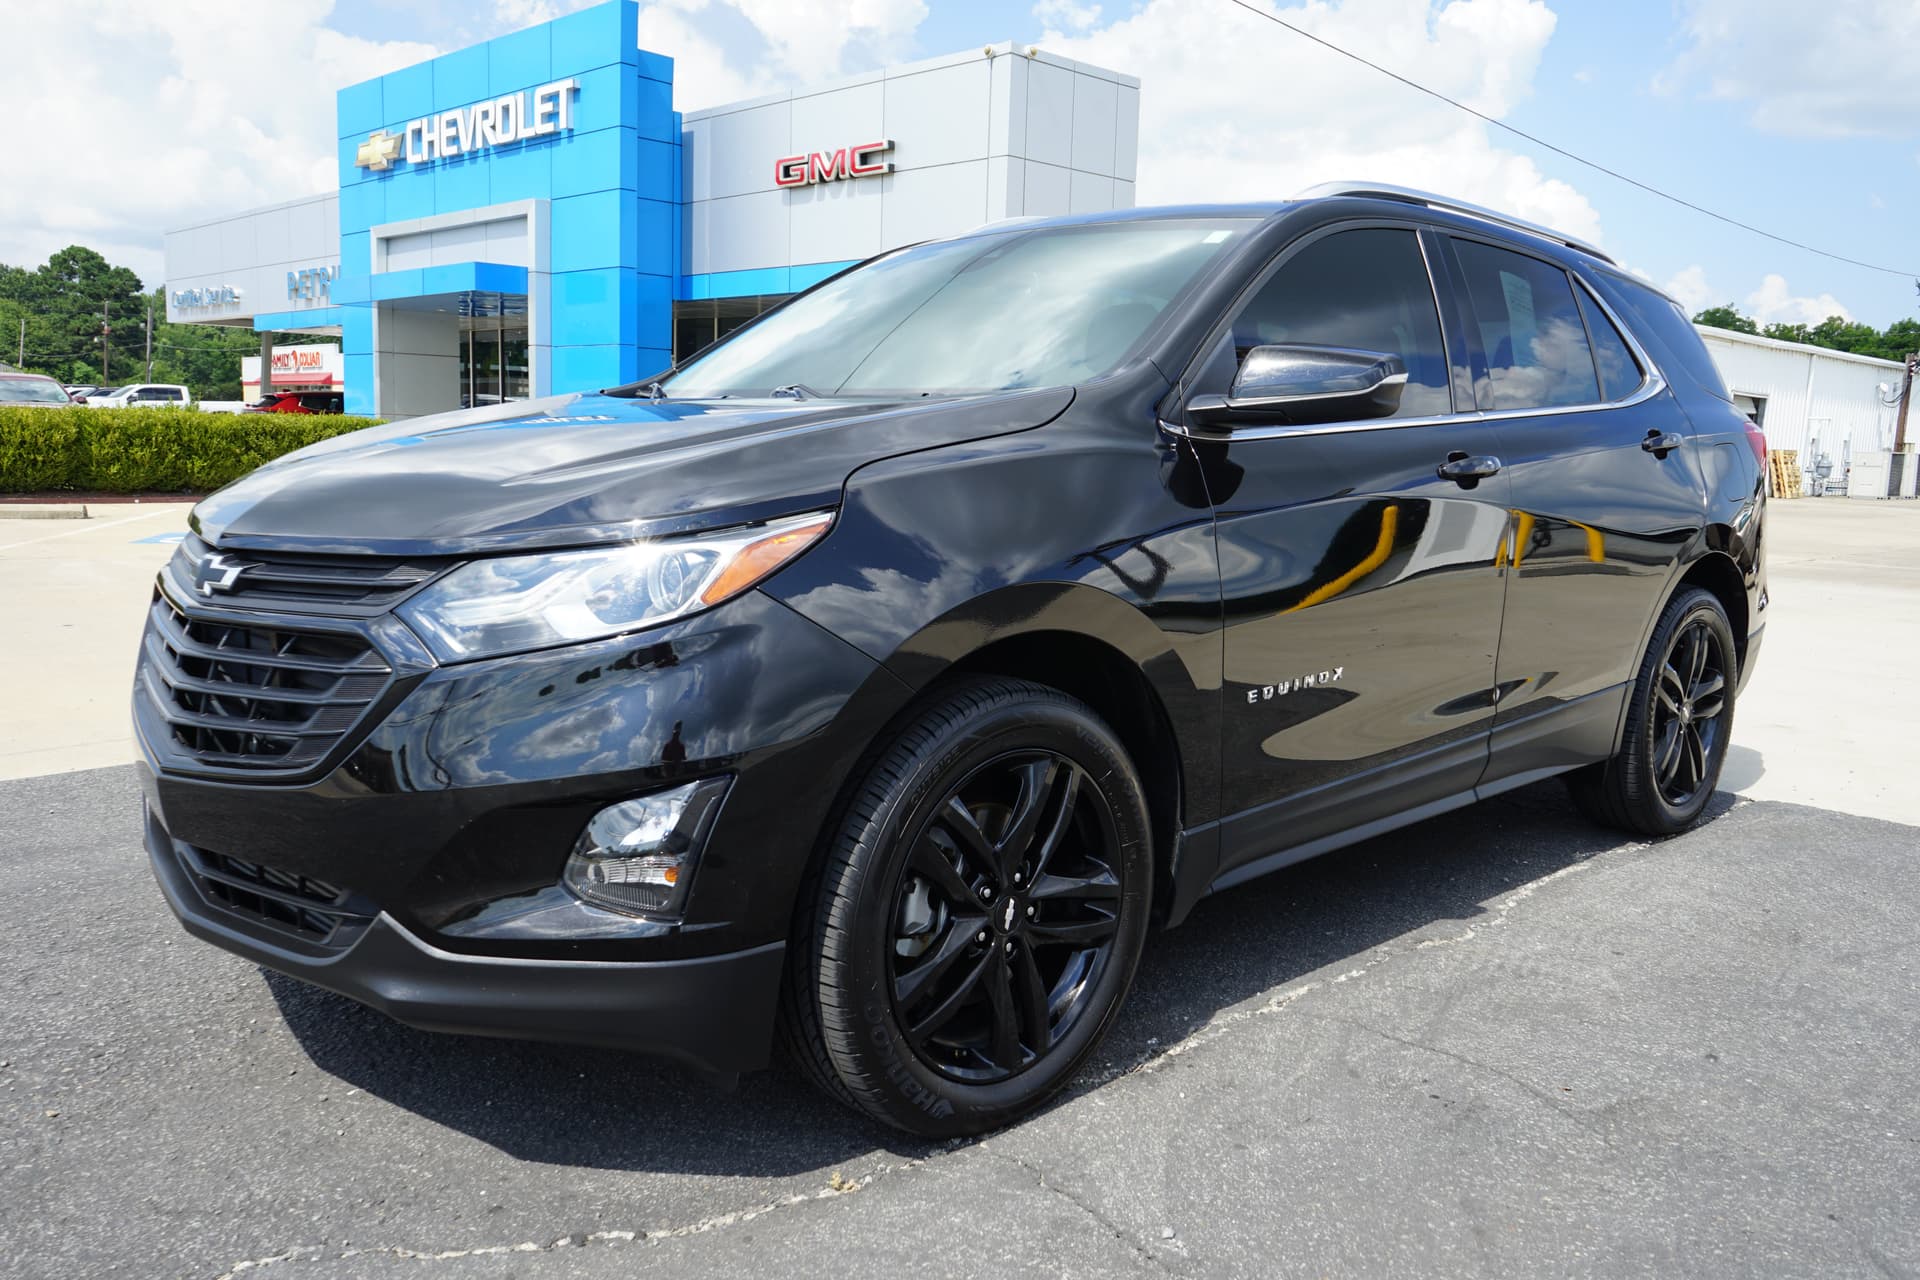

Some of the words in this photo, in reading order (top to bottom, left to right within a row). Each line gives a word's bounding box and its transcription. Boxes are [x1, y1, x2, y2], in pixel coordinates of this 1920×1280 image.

[406, 78, 577, 164] CHEVROLET
[775, 140, 893, 187] GMC
[300, 351, 320, 367] DOLLAR
[1247, 666, 1344, 704] EQUINOX
